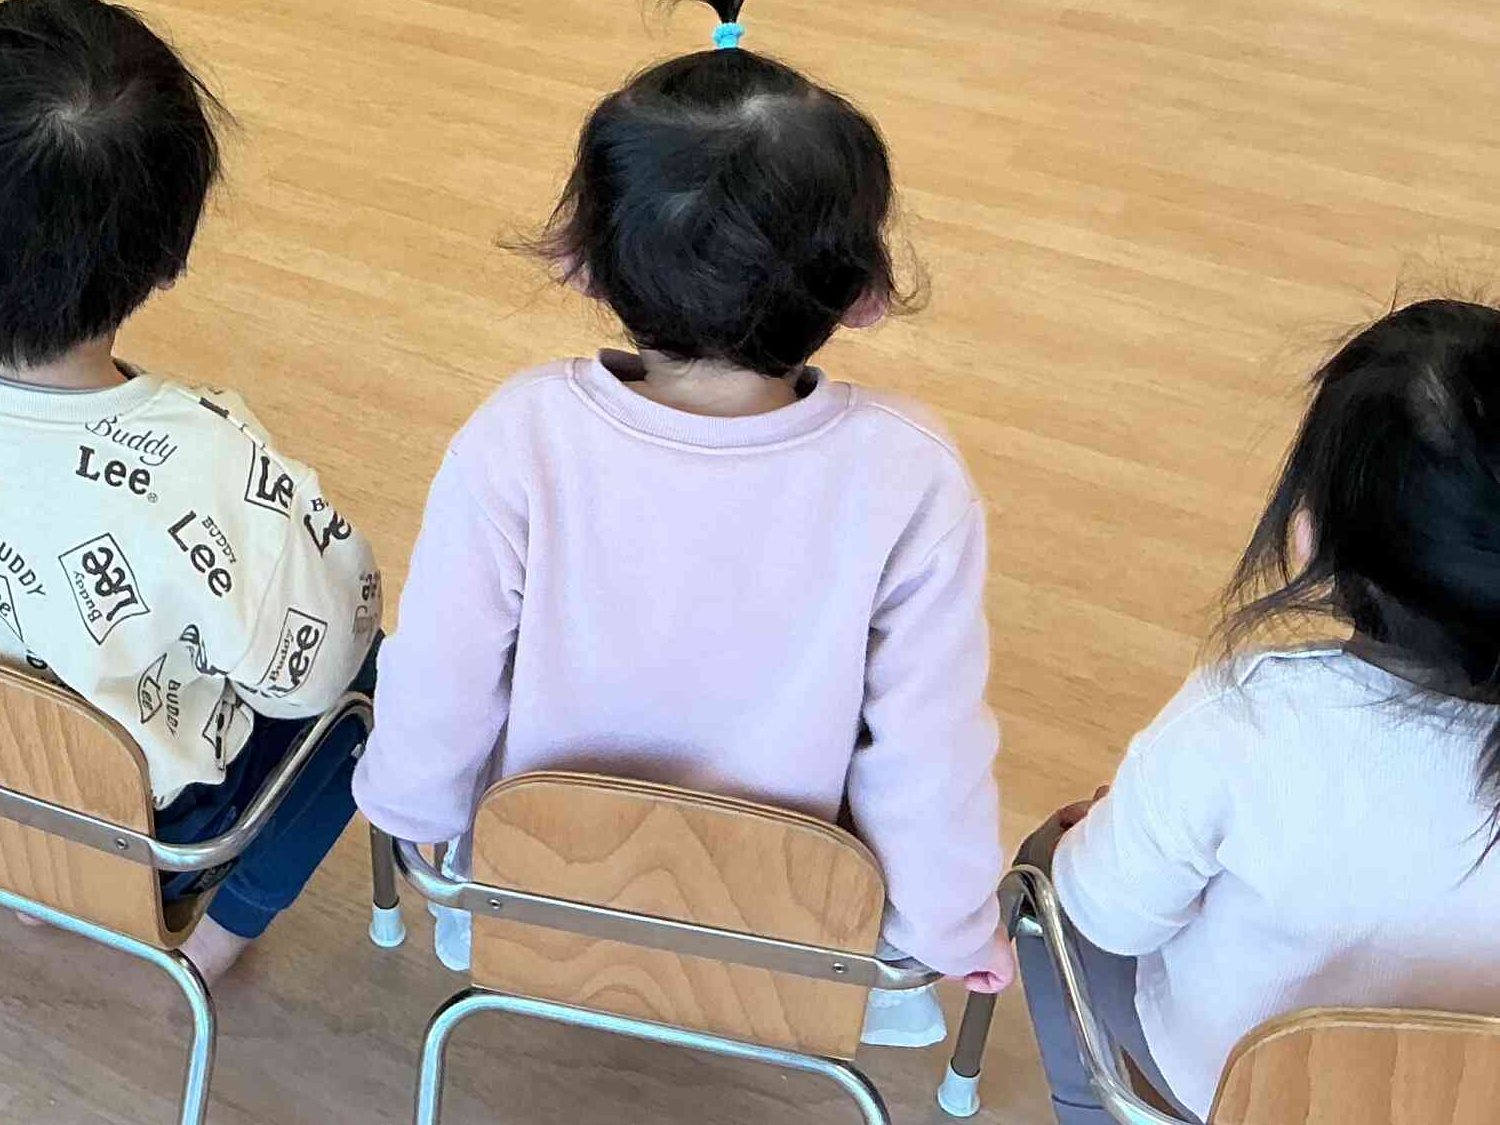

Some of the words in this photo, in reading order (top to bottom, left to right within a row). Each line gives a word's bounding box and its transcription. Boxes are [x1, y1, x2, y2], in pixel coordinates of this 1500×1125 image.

[84, 413, 178, 466] Buddy
[75, 445, 152, 496] Lee
[167, 510, 232, 598] Lee
[73, 570, 103, 623] Buddy
[82, 547, 138, 622] Lee
